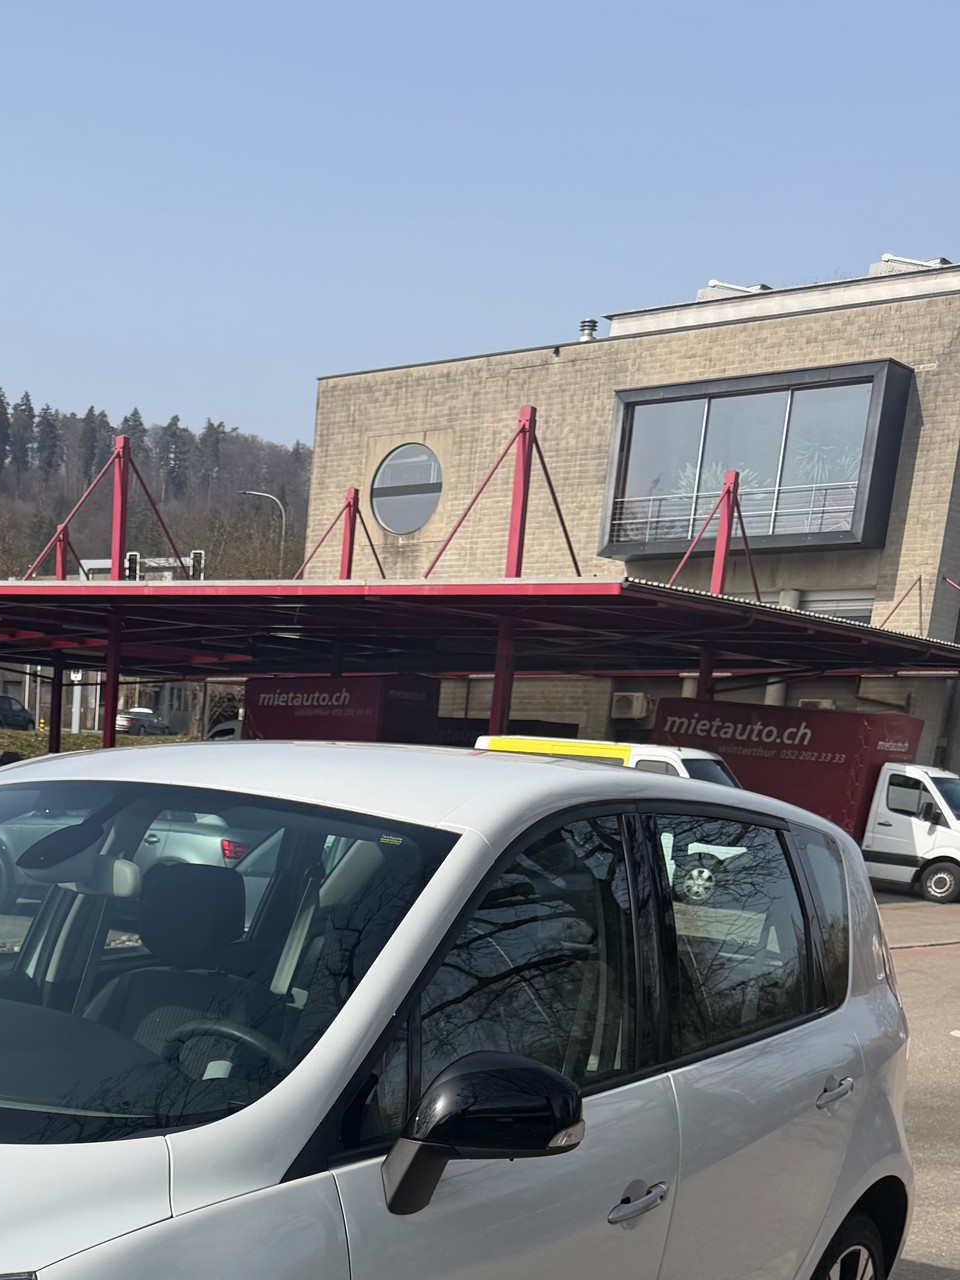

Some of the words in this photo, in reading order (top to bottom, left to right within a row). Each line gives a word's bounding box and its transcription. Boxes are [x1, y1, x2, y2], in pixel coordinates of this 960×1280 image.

[258, 688, 351, 706] mietauto.ch
[663, 713, 813, 746] mietauto.ch
[718, 744, 777, 758] winterthur
[780, 749, 798, 759] 052
[799, 751, 817, 761] 202
[817, 752, 832, 762] 33
[832, 753, 847, 764] 33
